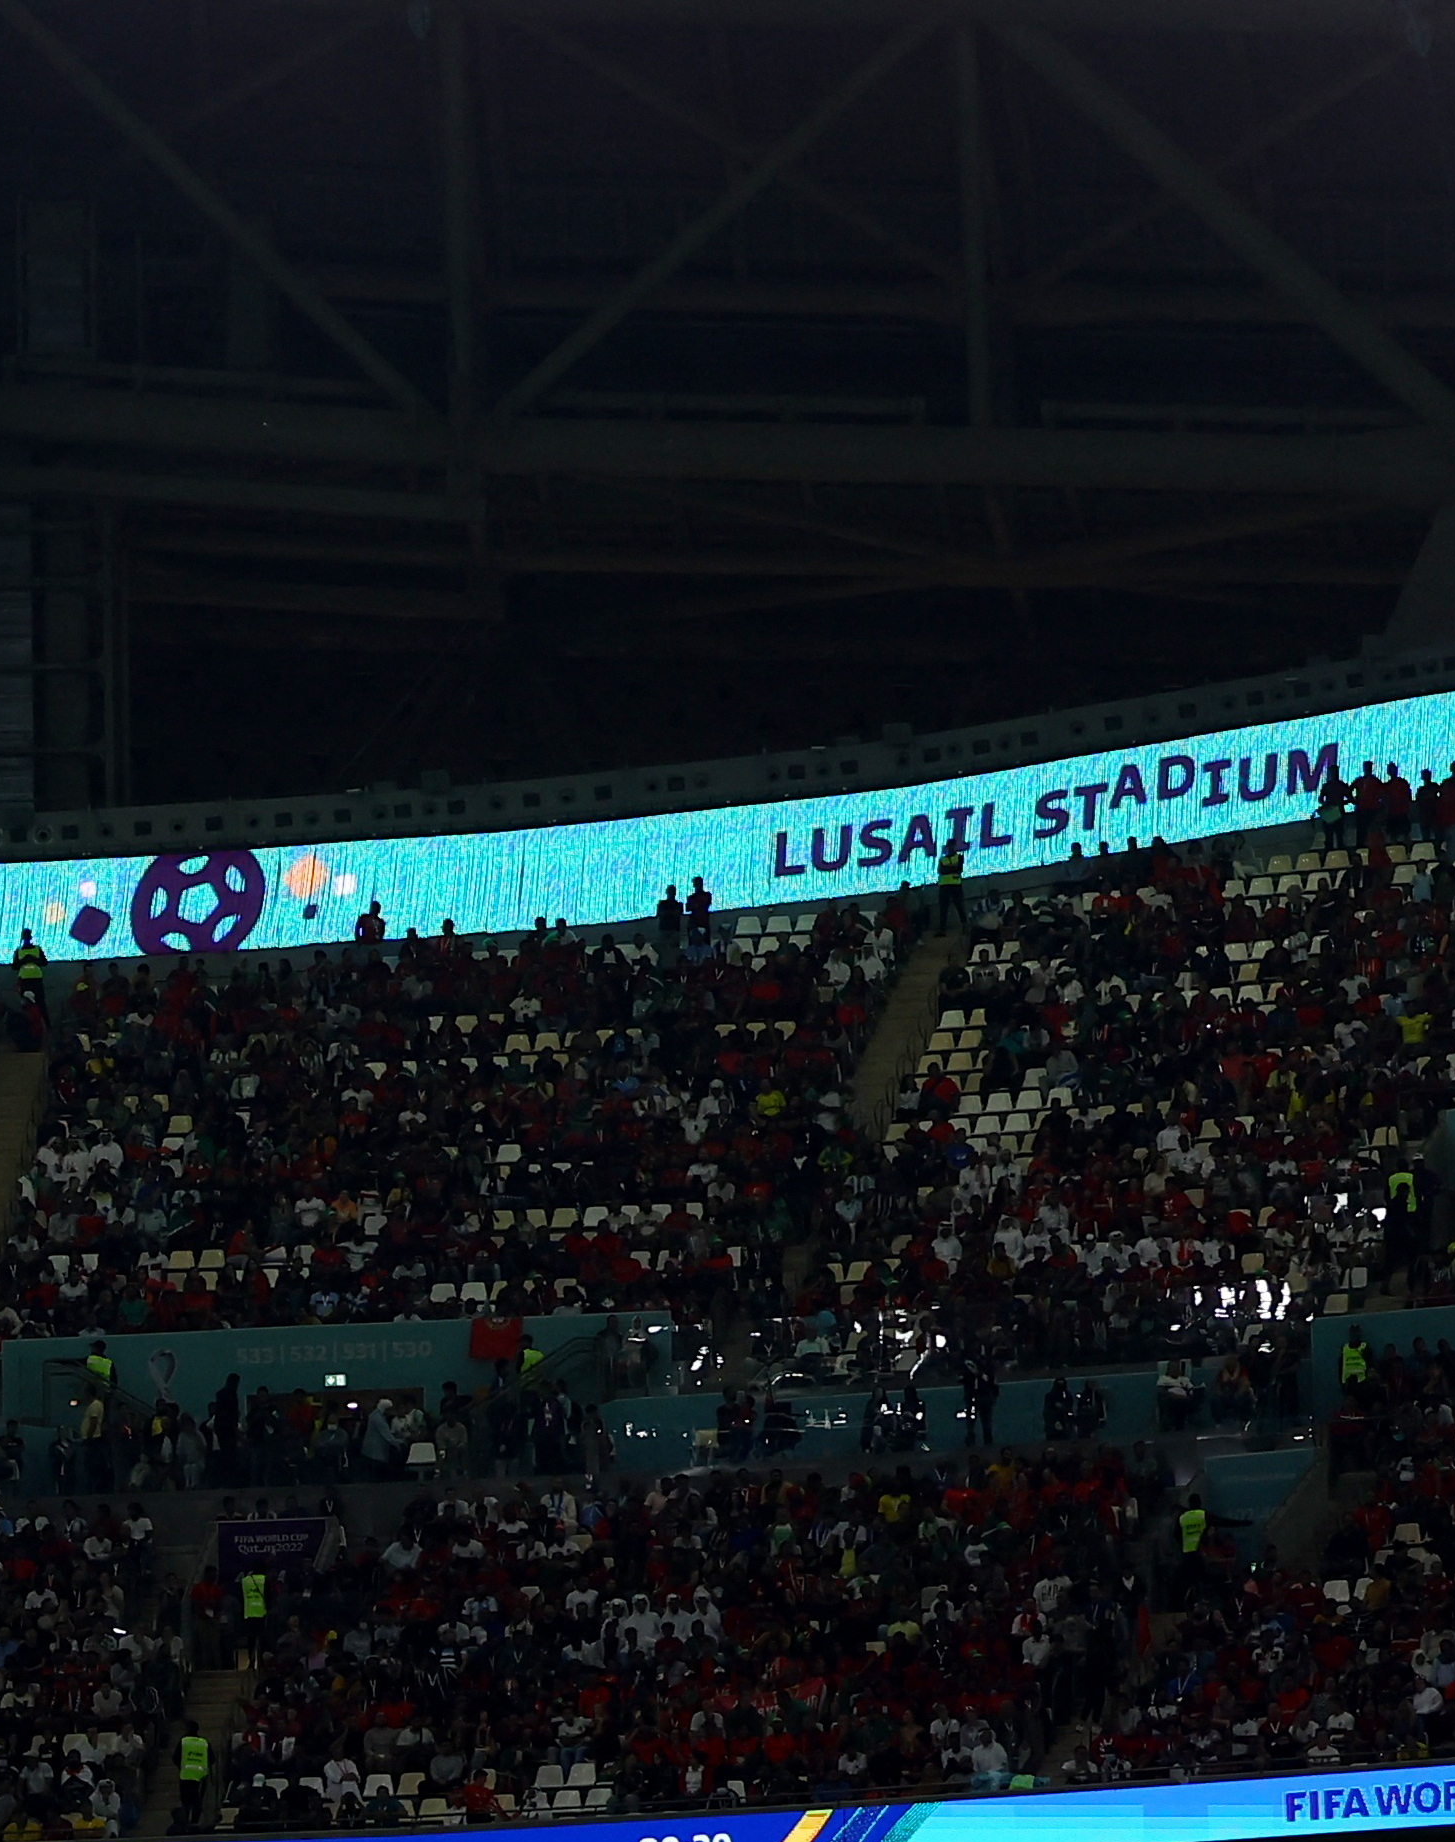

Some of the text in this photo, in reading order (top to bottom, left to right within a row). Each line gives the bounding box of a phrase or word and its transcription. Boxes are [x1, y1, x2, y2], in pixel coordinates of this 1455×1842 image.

[773, 743, 1339, 878] LUSAIL STADIUM
[1285, 1787, 1370, 1823] FIFA
